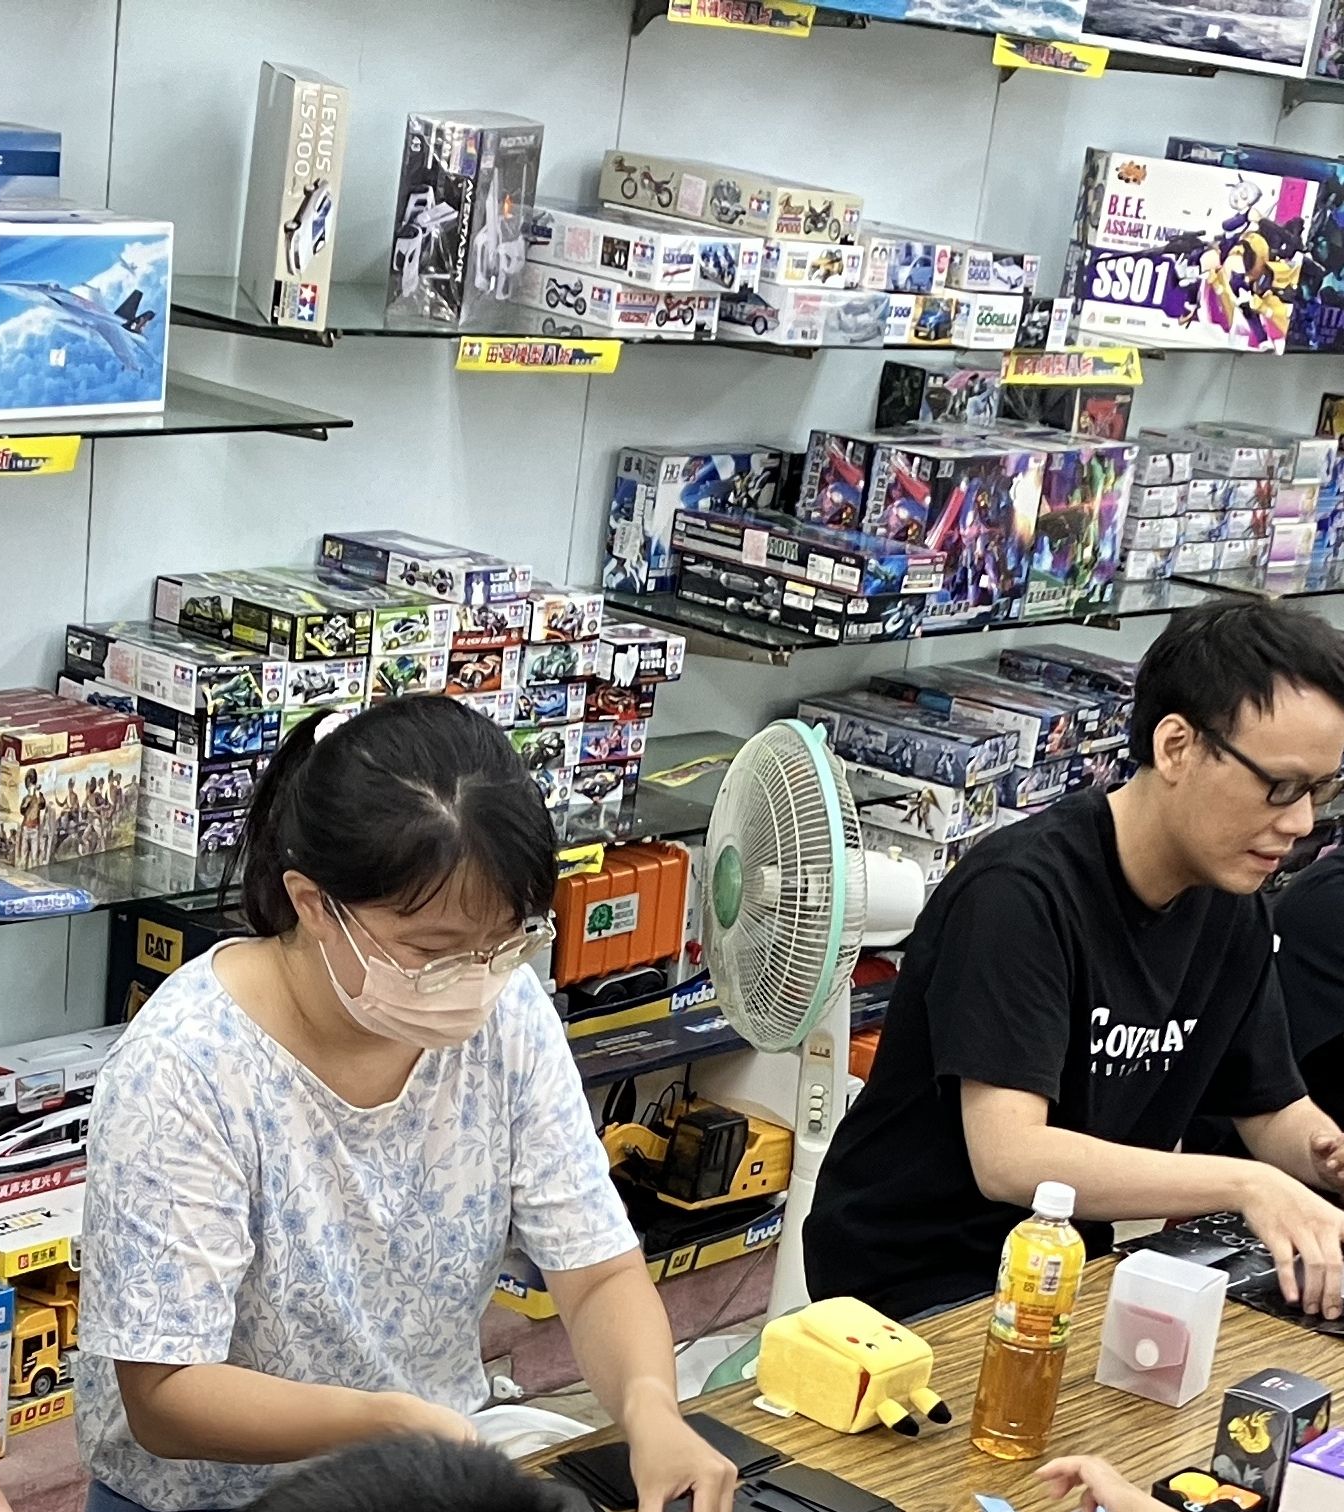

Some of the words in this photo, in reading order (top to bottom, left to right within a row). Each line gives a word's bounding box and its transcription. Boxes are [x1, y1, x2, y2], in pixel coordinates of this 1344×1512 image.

[315, 93, 339, 172] LEXUS
[1108, 194, 1147, 221] B.E.E.
[455, 179, 475, 284] AVENTADOR
[1104, 217, 1152, 240] ASSAULT
[968, 266, 991, 281] S600
[1093, 254, 1170, 306] SS01
[976, 312, 1017, 327] GORILLA
[663, 463, 681, 482] HG
[145, 932, 174, 962] CAT
[75, 1069, 98, 1082] HIGH
[673, 1251, 691, 1268] CAT
